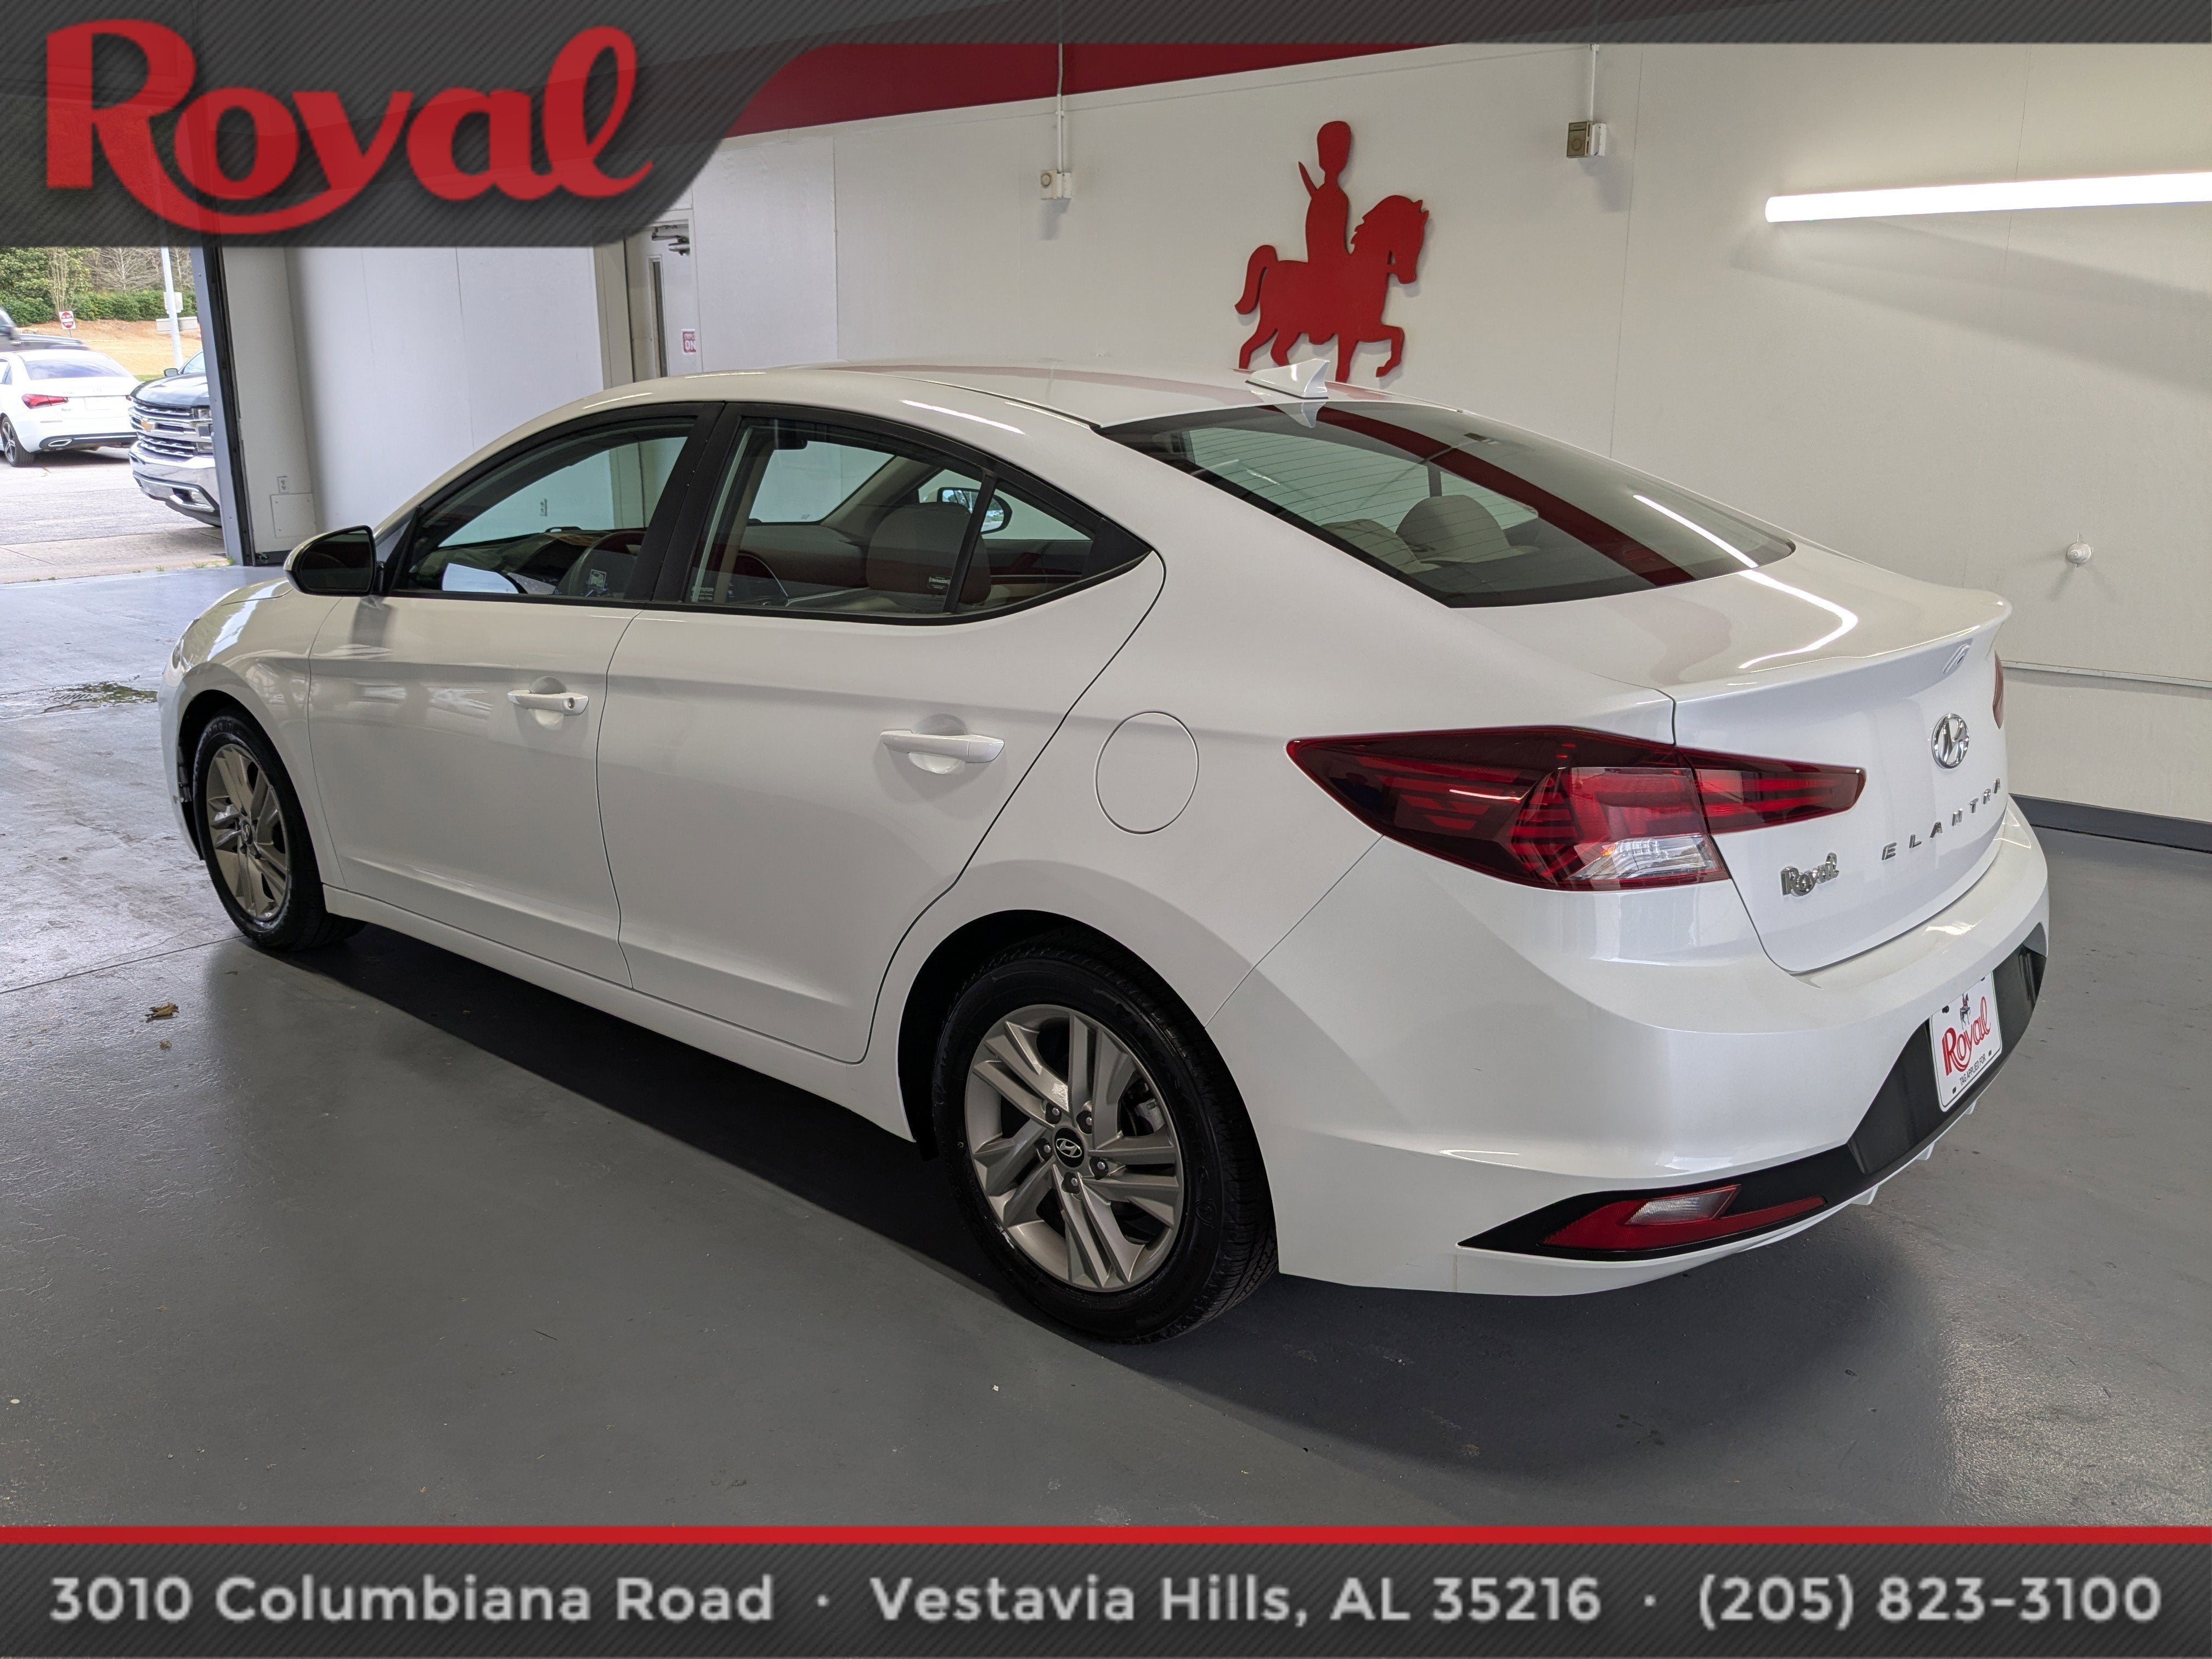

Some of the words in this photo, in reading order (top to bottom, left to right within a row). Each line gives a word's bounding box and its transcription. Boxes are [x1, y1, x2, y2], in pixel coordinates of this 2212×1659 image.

[1881, 778, 2001, 861] ELANTRA
[1780, 851, 1840, 897] Royal
[1941, 996, 1991, 1077] Royal
[1967, 1060, 1979, 1080] APPLIED
